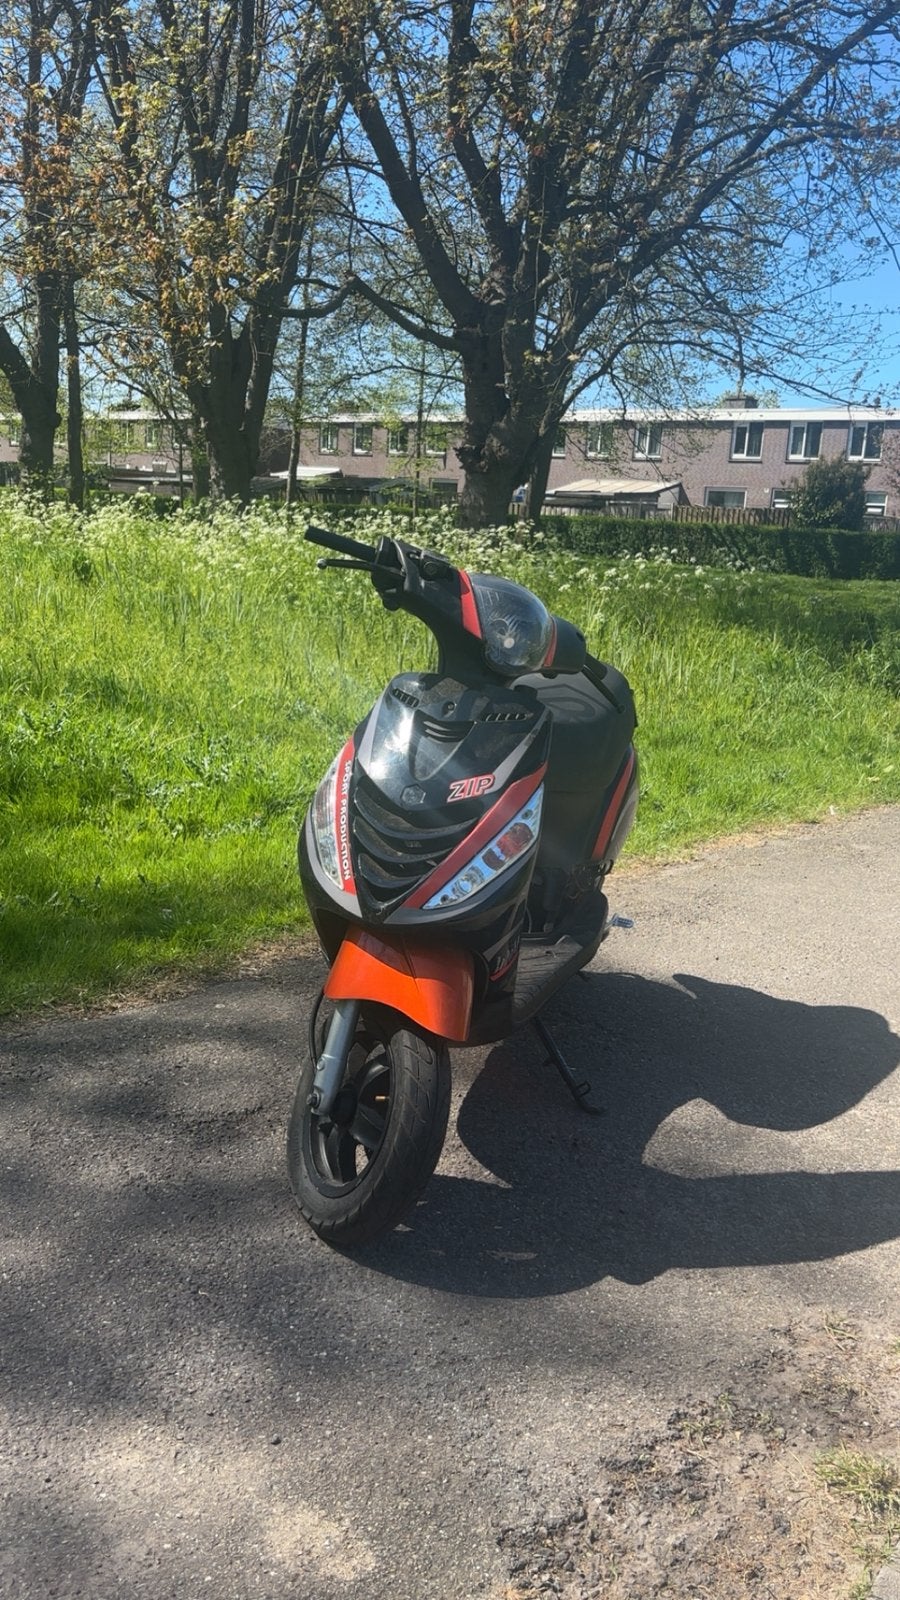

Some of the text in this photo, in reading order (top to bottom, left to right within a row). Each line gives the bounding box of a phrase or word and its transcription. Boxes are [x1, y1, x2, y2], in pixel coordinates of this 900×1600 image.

[340, 760, 352, 881] SPORT PRODUCTION
[447, 774, 496, 803] ZIP
